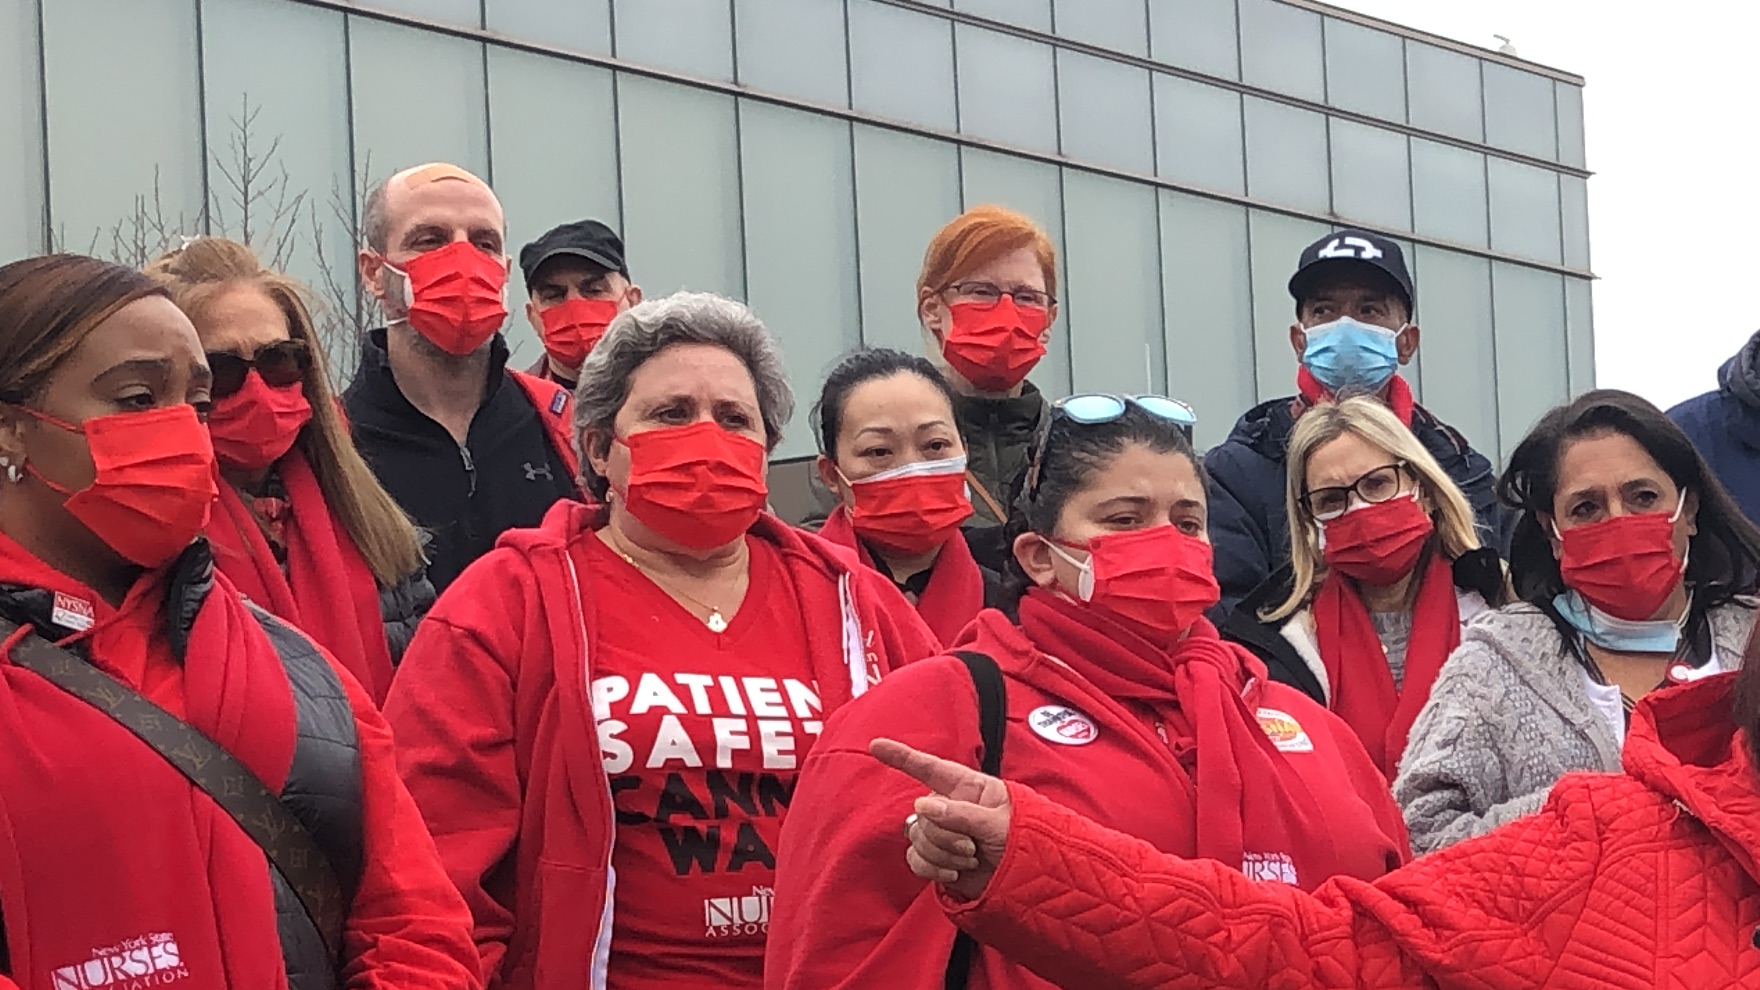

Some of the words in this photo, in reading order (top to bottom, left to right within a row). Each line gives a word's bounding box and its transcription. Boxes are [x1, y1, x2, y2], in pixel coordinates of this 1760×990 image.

[592, 672, 823, 723] PATIEN
[597, 715, 824, 774] SAFE
[609, 770, 801, 825] CANN
[659, 822, 777, 875] WA
[91, 942, 120, 957] New
[120, 933, 148, 950] York
